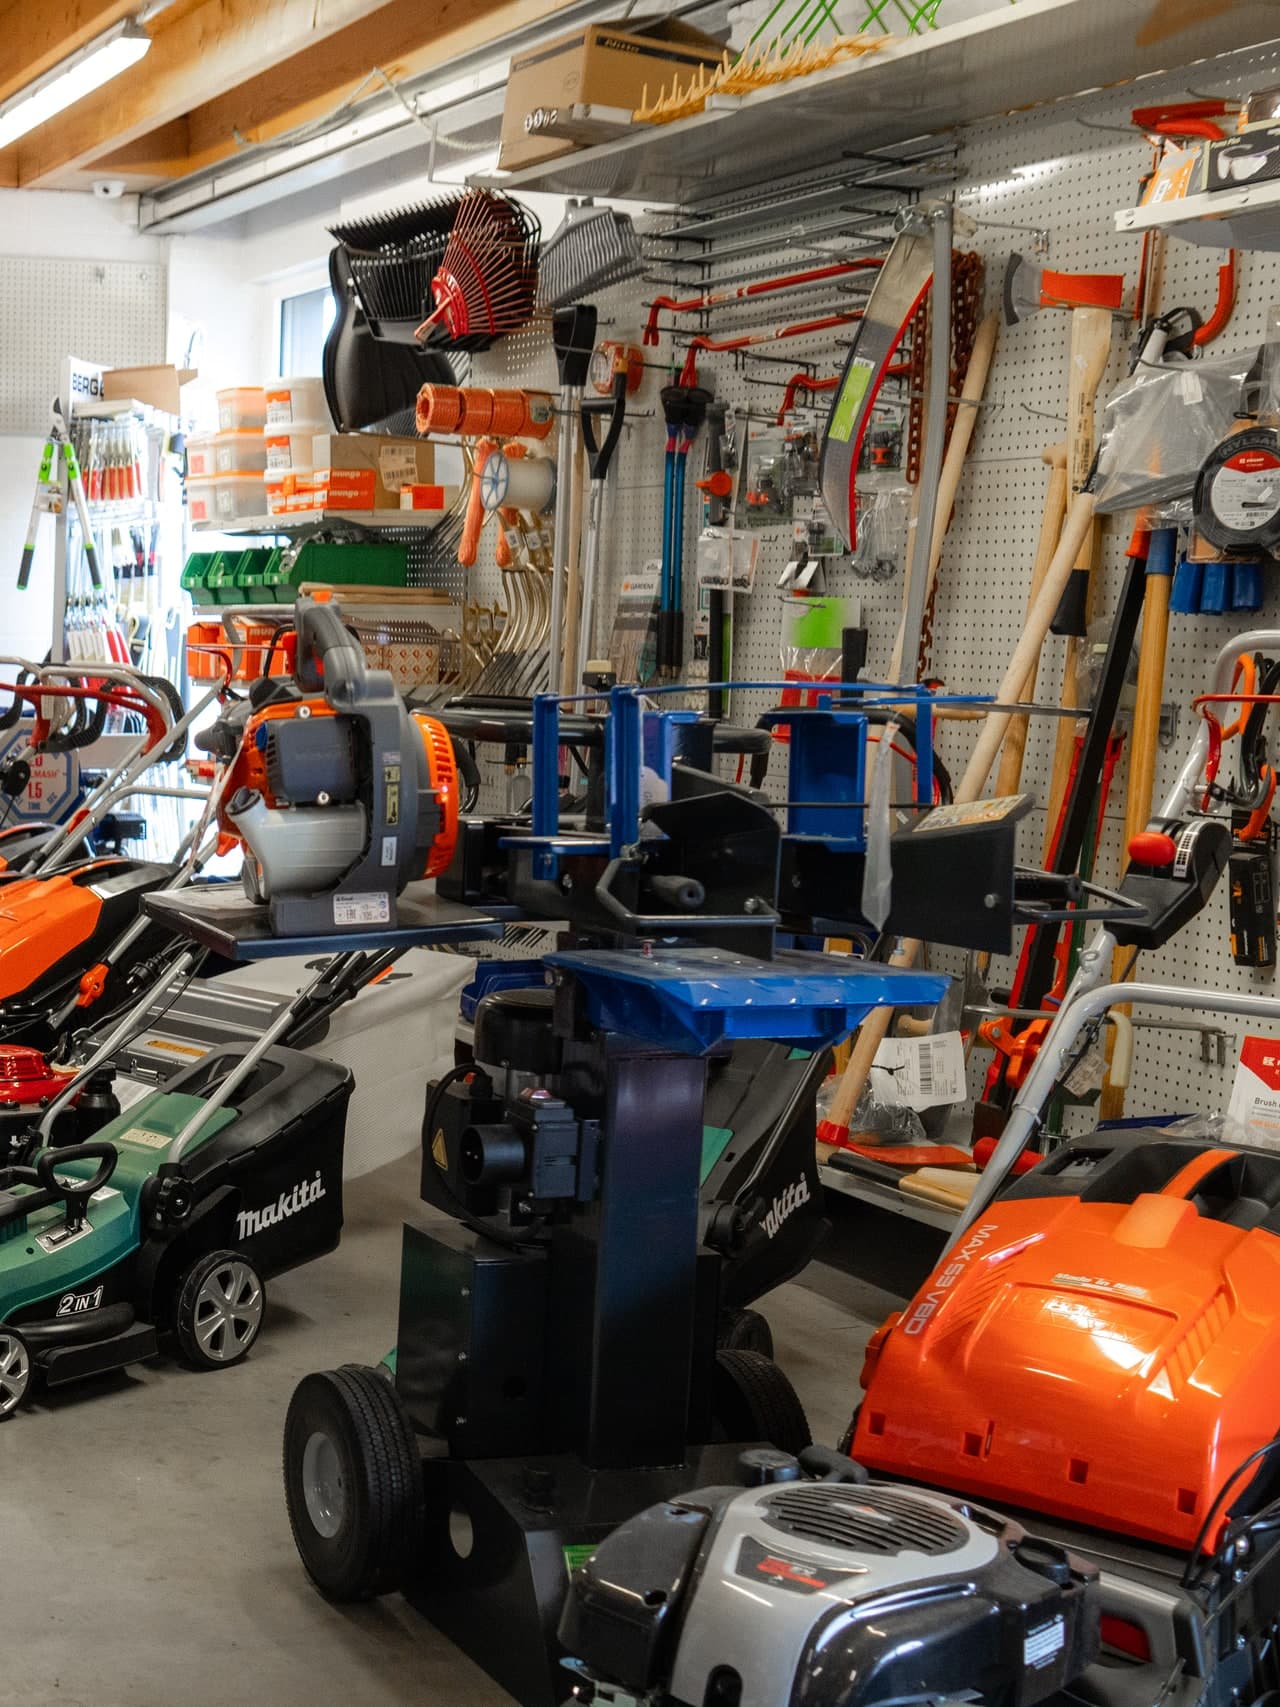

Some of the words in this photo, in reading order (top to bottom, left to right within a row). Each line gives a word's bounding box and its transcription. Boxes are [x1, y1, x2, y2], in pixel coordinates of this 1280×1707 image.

[1254, 1097, 1278, 1107] Brush
[954, 1224, 999, 1261] MAX
[57, 1296, 74, 1316] 2
[74, 1297, 90, 1311] IN
[92, 1287, 104, 1308] 1
